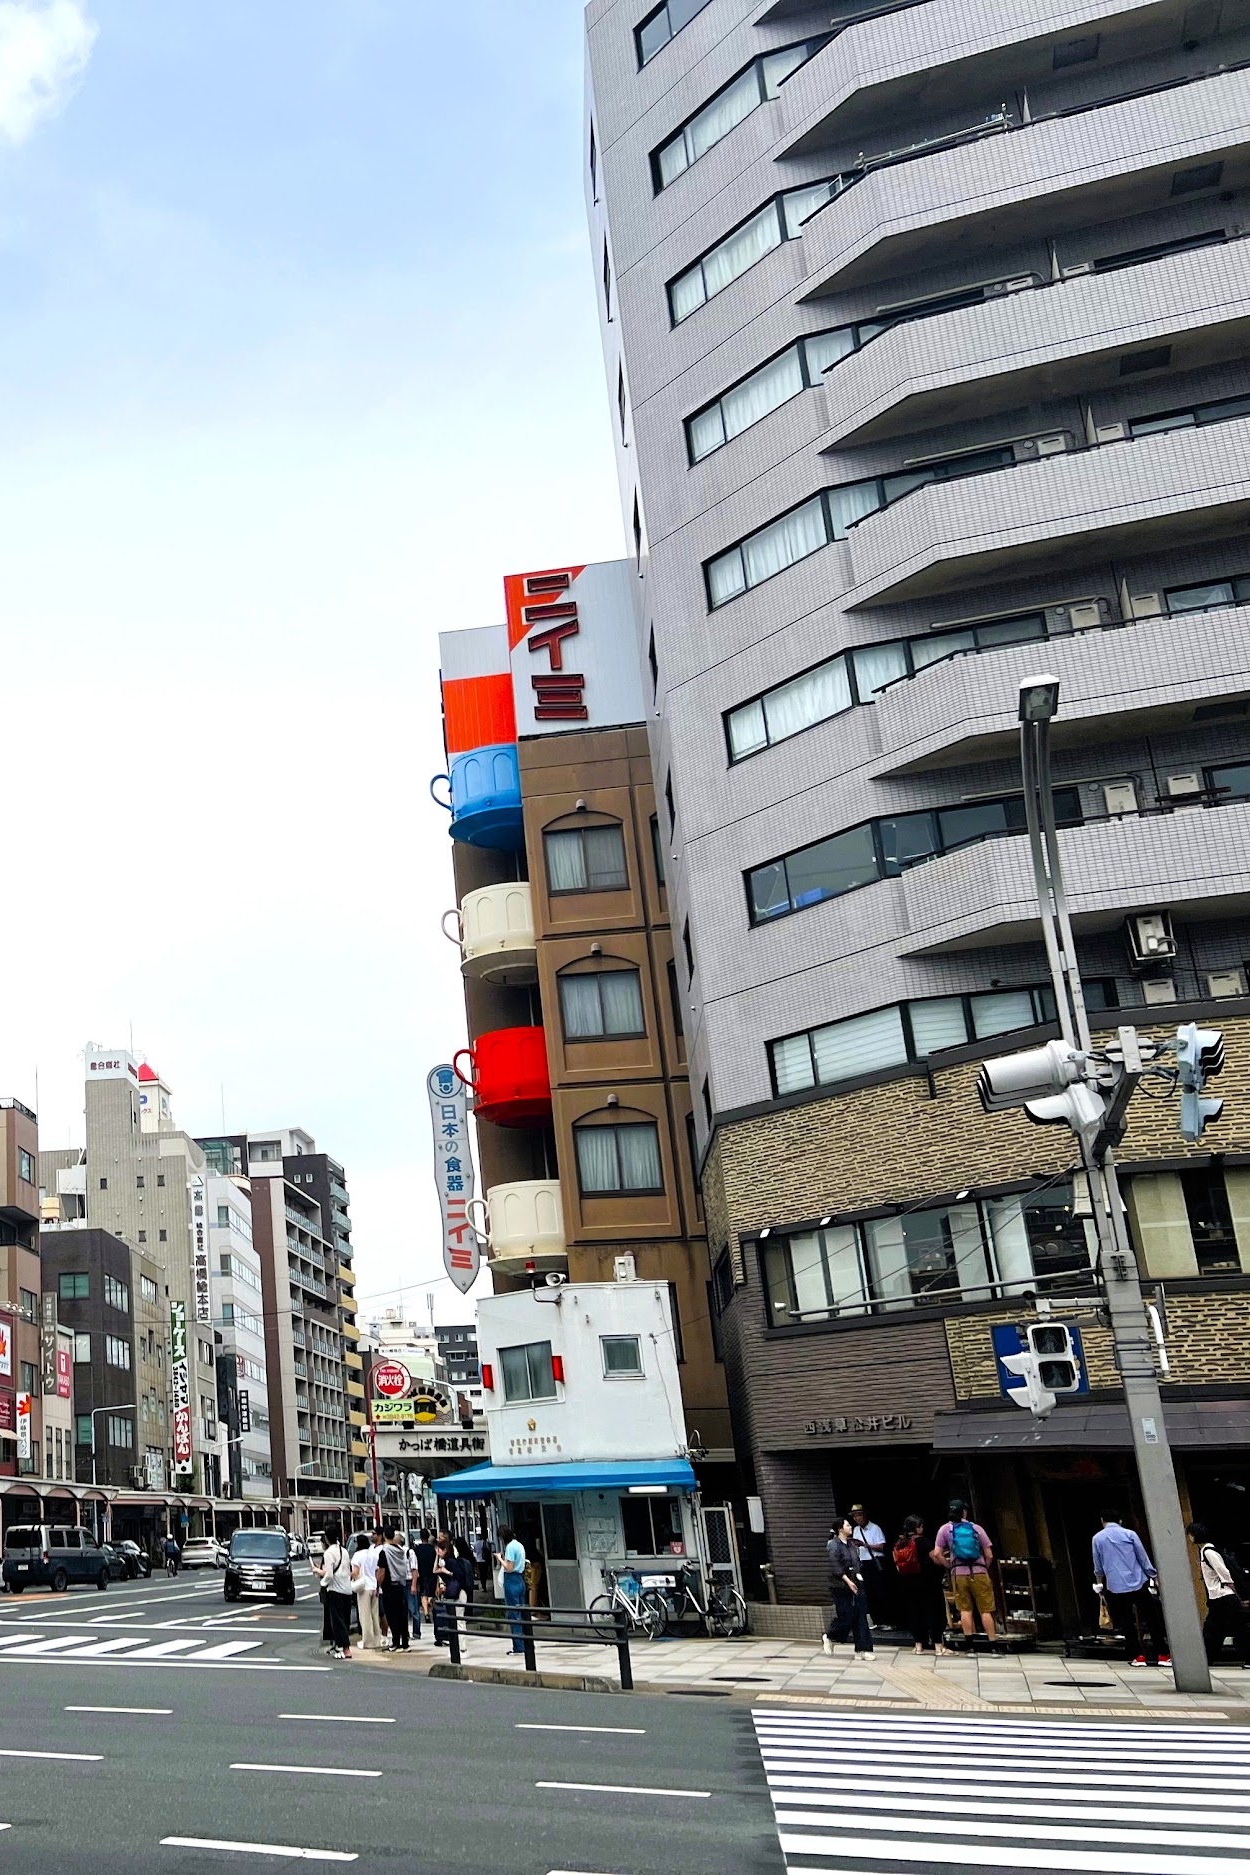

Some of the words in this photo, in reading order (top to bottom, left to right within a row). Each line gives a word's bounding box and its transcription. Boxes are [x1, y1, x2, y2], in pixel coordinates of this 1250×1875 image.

[524, 573, 588, 720] ニイミ
[440, 1104, 465, 1192] 日本の食器
[446, 1199, 474, 1270] ニイミ
[171, 1301, 186, 1357] ショーケース
[44, 1335, 55, 1389] サイトウ
[377, 1373, 404, 1387] 消火栓
[175, 1411, 190, 1455] かんばん
[373, 1402, 413, 1413] カジワラ
